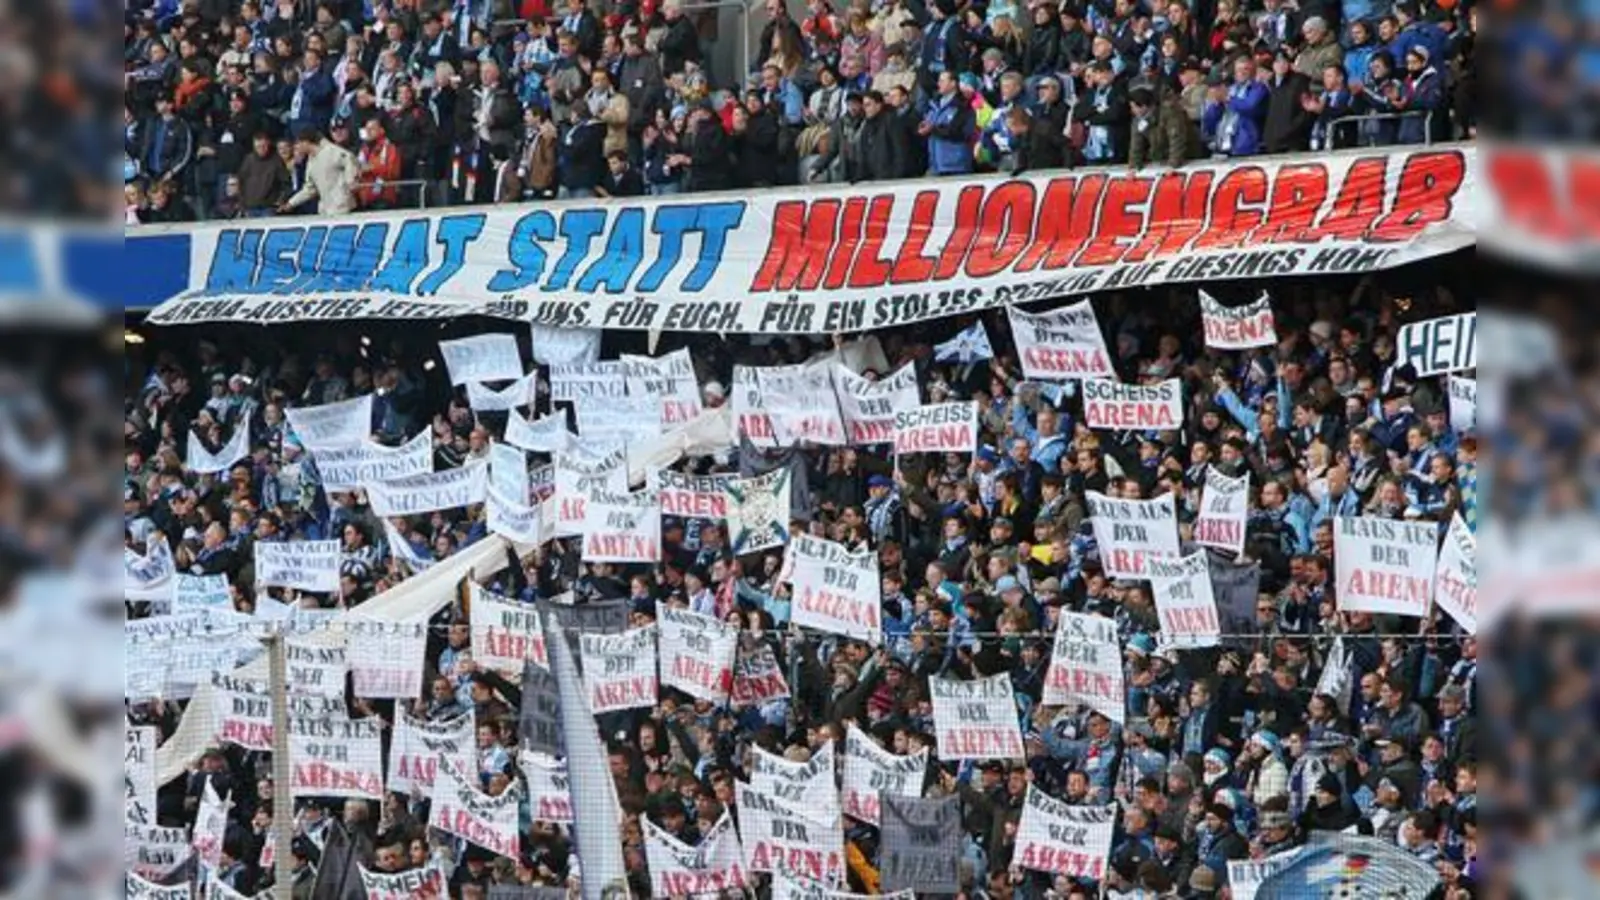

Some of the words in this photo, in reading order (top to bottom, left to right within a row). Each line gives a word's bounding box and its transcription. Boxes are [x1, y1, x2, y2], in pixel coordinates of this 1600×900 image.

[206, 213, 486, 296] HEIMAT
[490, 200, 747, 295] STATT
[750, 150, 1466, 292] MILLIONENGRAB
[602, 298, 660, 327] FÜR
[663, 302, 743, 331] EUCH.
[758, 294, 817, 331] FÜR
[822, 298, 868, 331] EIN
[1102, 259, 1165, 287] AUF
[1165, 248, 1306, 279] GIESINGS
[1024, 346, 1107, 373] ARENA
[1085, 381, 1173, 401] SCHEISS
[661, 400, 700, 425] ENA
[895, 404, 973, 430] SCHEISS
[1086, 401, 1174, 427] ARENA
[896, 424, 972, 452] ARENA
[658, 491, 727, 517] AREN
[1137, 501, 1172, 520] AUS
[1113, 522, 1149, 542] DER
[1342, 517, 1396, 541] RAUS
[1401, 525, 1437, 546] AUS
[587, 532, 657, 558] ARENA
[1370, 544, 1410, 568] DER
[823, 566, 859, 591] DER
[797, 582, 878, 628] ARENA
[222, 719, 275, 749] AREN
[944, 728, 1021, 756] ARENA
[771, 819, 810, 843] DER
